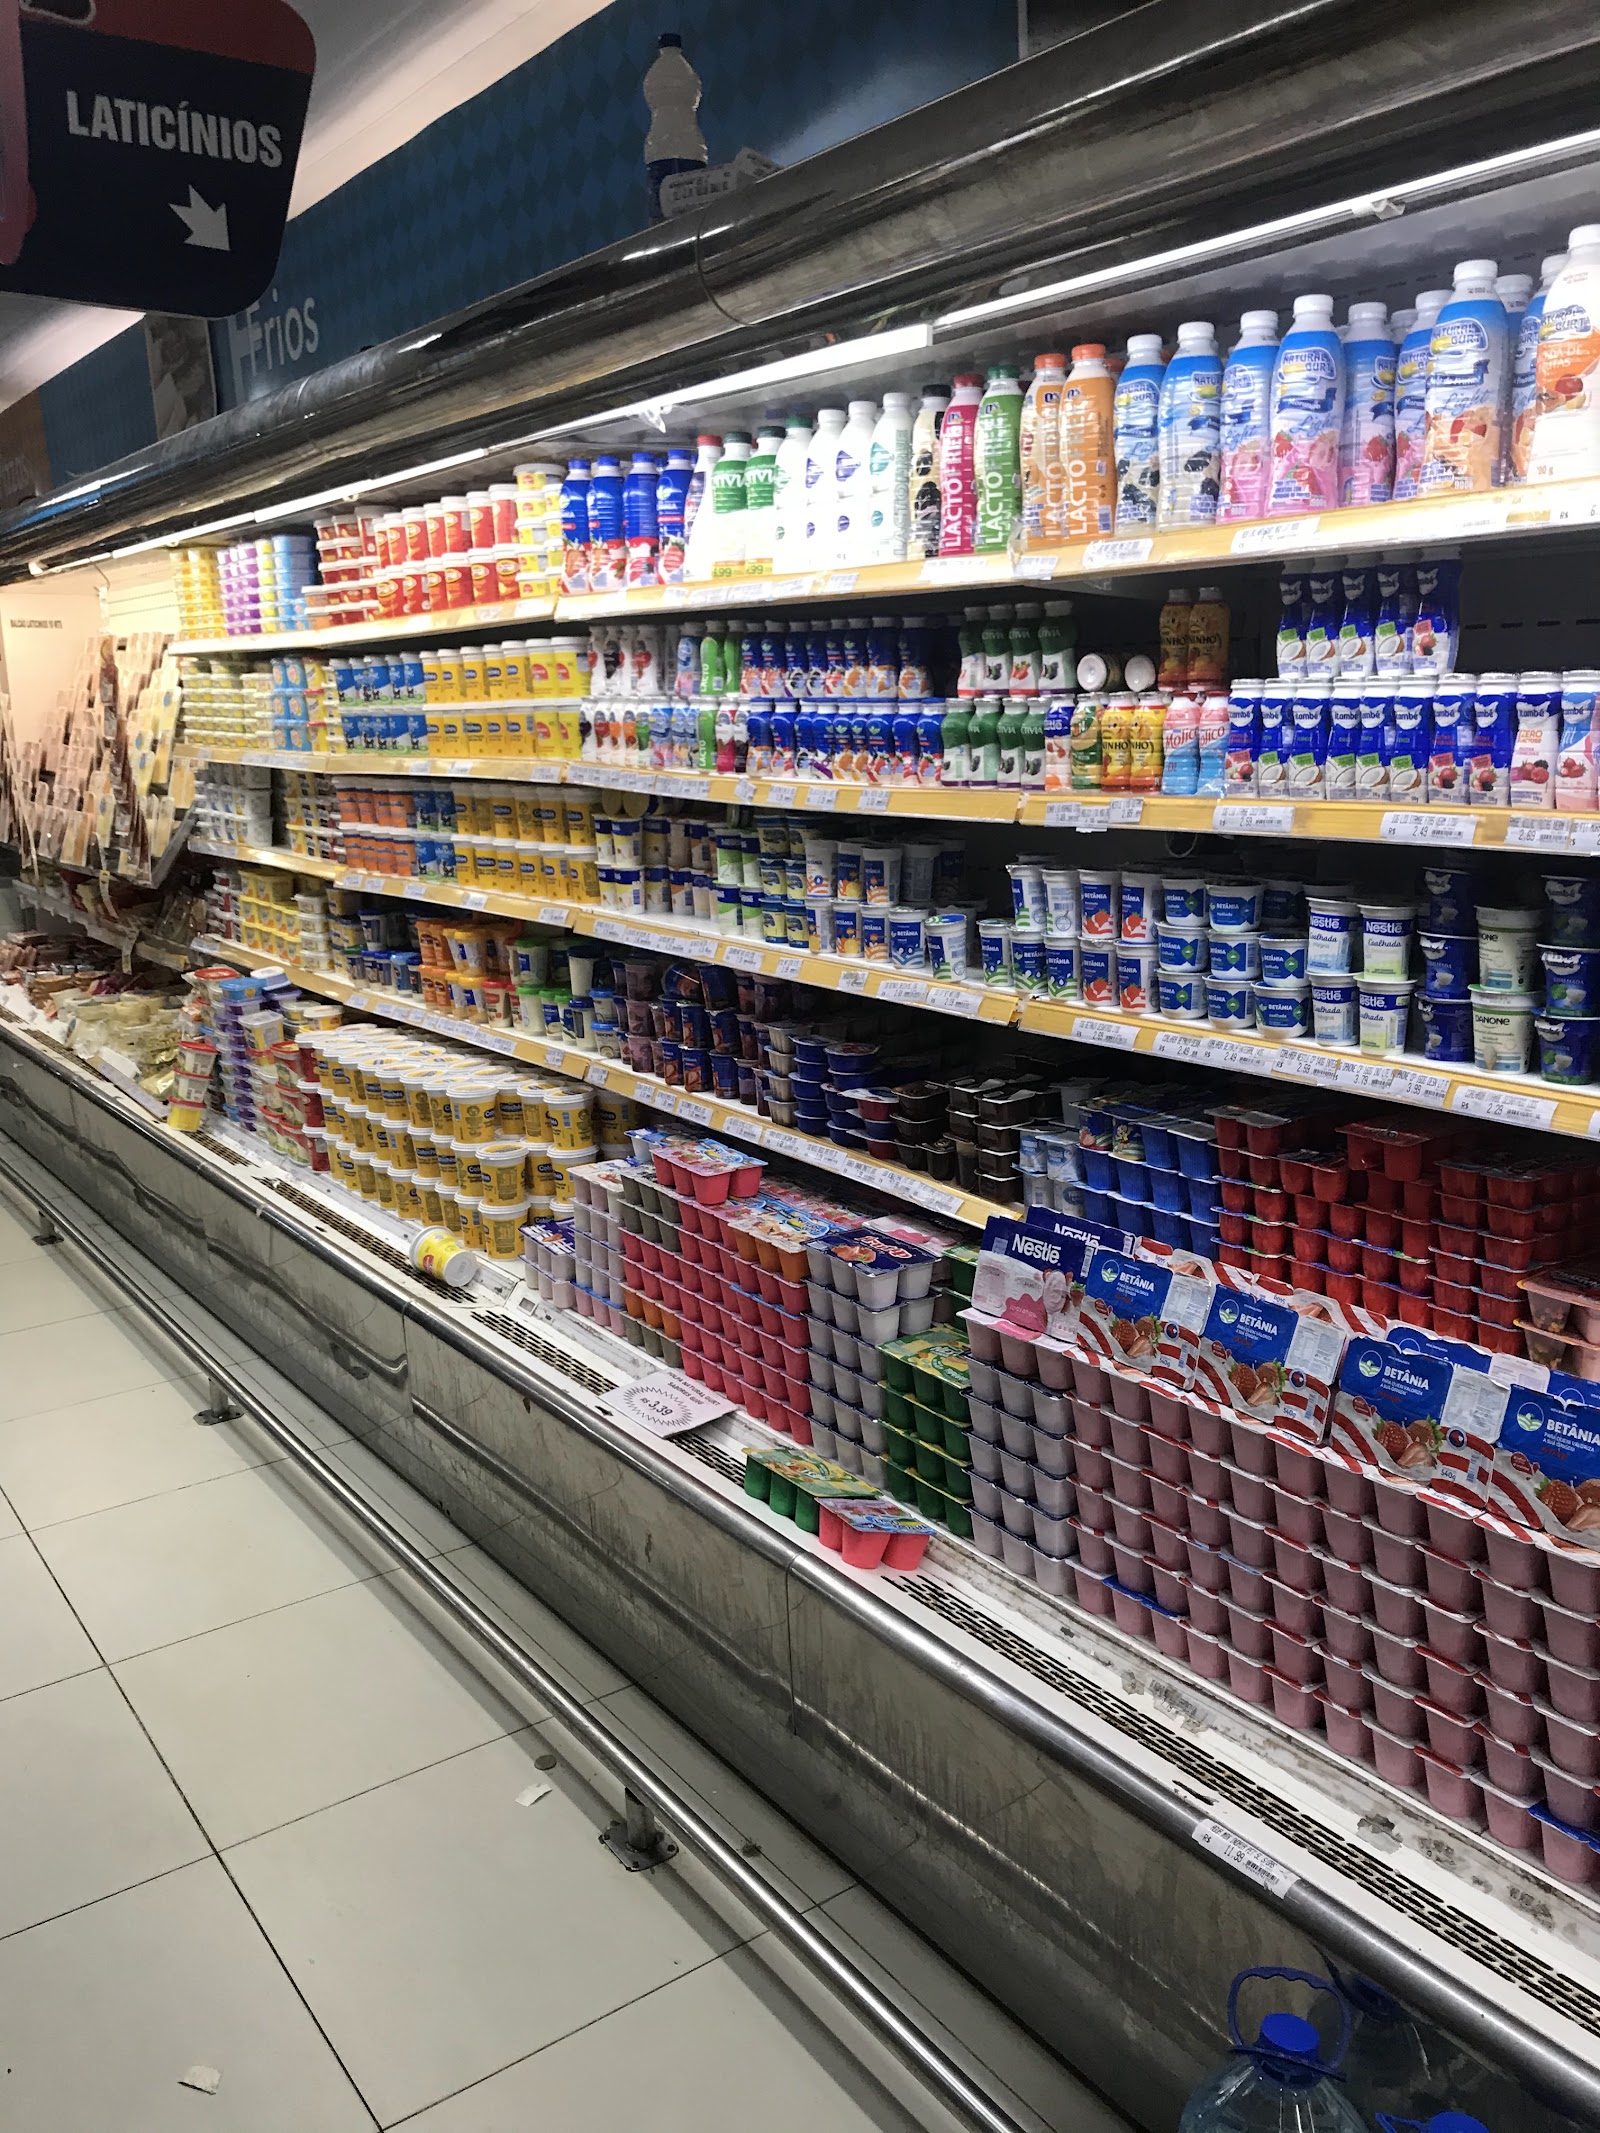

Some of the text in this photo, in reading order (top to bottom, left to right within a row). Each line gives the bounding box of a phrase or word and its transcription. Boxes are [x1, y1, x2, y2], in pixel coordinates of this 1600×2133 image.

[66, 89, 282, 168] LATICÍNIOS
[240, 288, 319, 379] Frios
[1069, 459, 1088, 535] LACTO
[945, 475, 963, 548] LACTO
[985, 470, 1004, 544] LACTO
[701, 664, 709, 694] LACTO
[1229, 710, 1251, 720] també
[1262, 711, 1279, 720] ambé
[1361, 710, 1381, 720] ambé
[1396, 710, 1419, 721] també
[1435, 708, 1456, 718] ambé
[1476, 708, 1493, 719] ambé
[1564, 707, 1584, 716] ambé
[1166, 726, 1199, 749] Molico
[1200, 726, 1225, 748] olico
[1520, 730, 1544, 738] ZERO
[699, 741, 707, 769] LACTO
[1413, 825, 1428, 837] 2.49
[1519, 829, 1536, 841] 2.69
[1085, 891, 1108, 900] BETÂNIA
[1217, 902, 1240, 910] BETÂNIA
[1310, 914, 1340, 930] Nestlé
[1366, 920, 1402, 934] Nestlé
[897, 929, 919, 937] BETÂNIA
[1479, 932, 1498, 942] NONE
[1368, 938, 1402, 948] Coalhada
[1049, 956, 1070, 965] BETÂNIA
[1312, 989, 1342, 1001] Nestlé
[1268, 1003, 1292, 1012] BETÂNIA
[1360, 996, 1385, 1008] estlé
[1360, 1013, 1385, 1021] alhada
[1475, 1015, 1510, 1026] DANONE
[1224, 1053, 1236, 1062] 2.49
[1355, 1073, 1369, 1085] 3.79
[1407, 1082, 1420, 1094] 3.99
[1460, 1101, 1503, 1115] R$ 2.29
[1012, 1233, 1061, 1265] Nestlé
[1119, 1271, 1155, 1293] BETÂNIA
[1239, 1313, 1277, 1336] BETÂNIA
[1384, 1365, 1429, 1391] BETÂNIA
[667, 1381, 690, 1397] SABORES
[648, 1400, 673, 1417] 3,39
[1283, 1407, 1296, 1418] 540g
[1546, 1418, 1600, 1445] BETÂNIA
[1440, 1467, 1456, 1480] 540g
[1203, 1833, 1245, 1863] R$ 11.99
